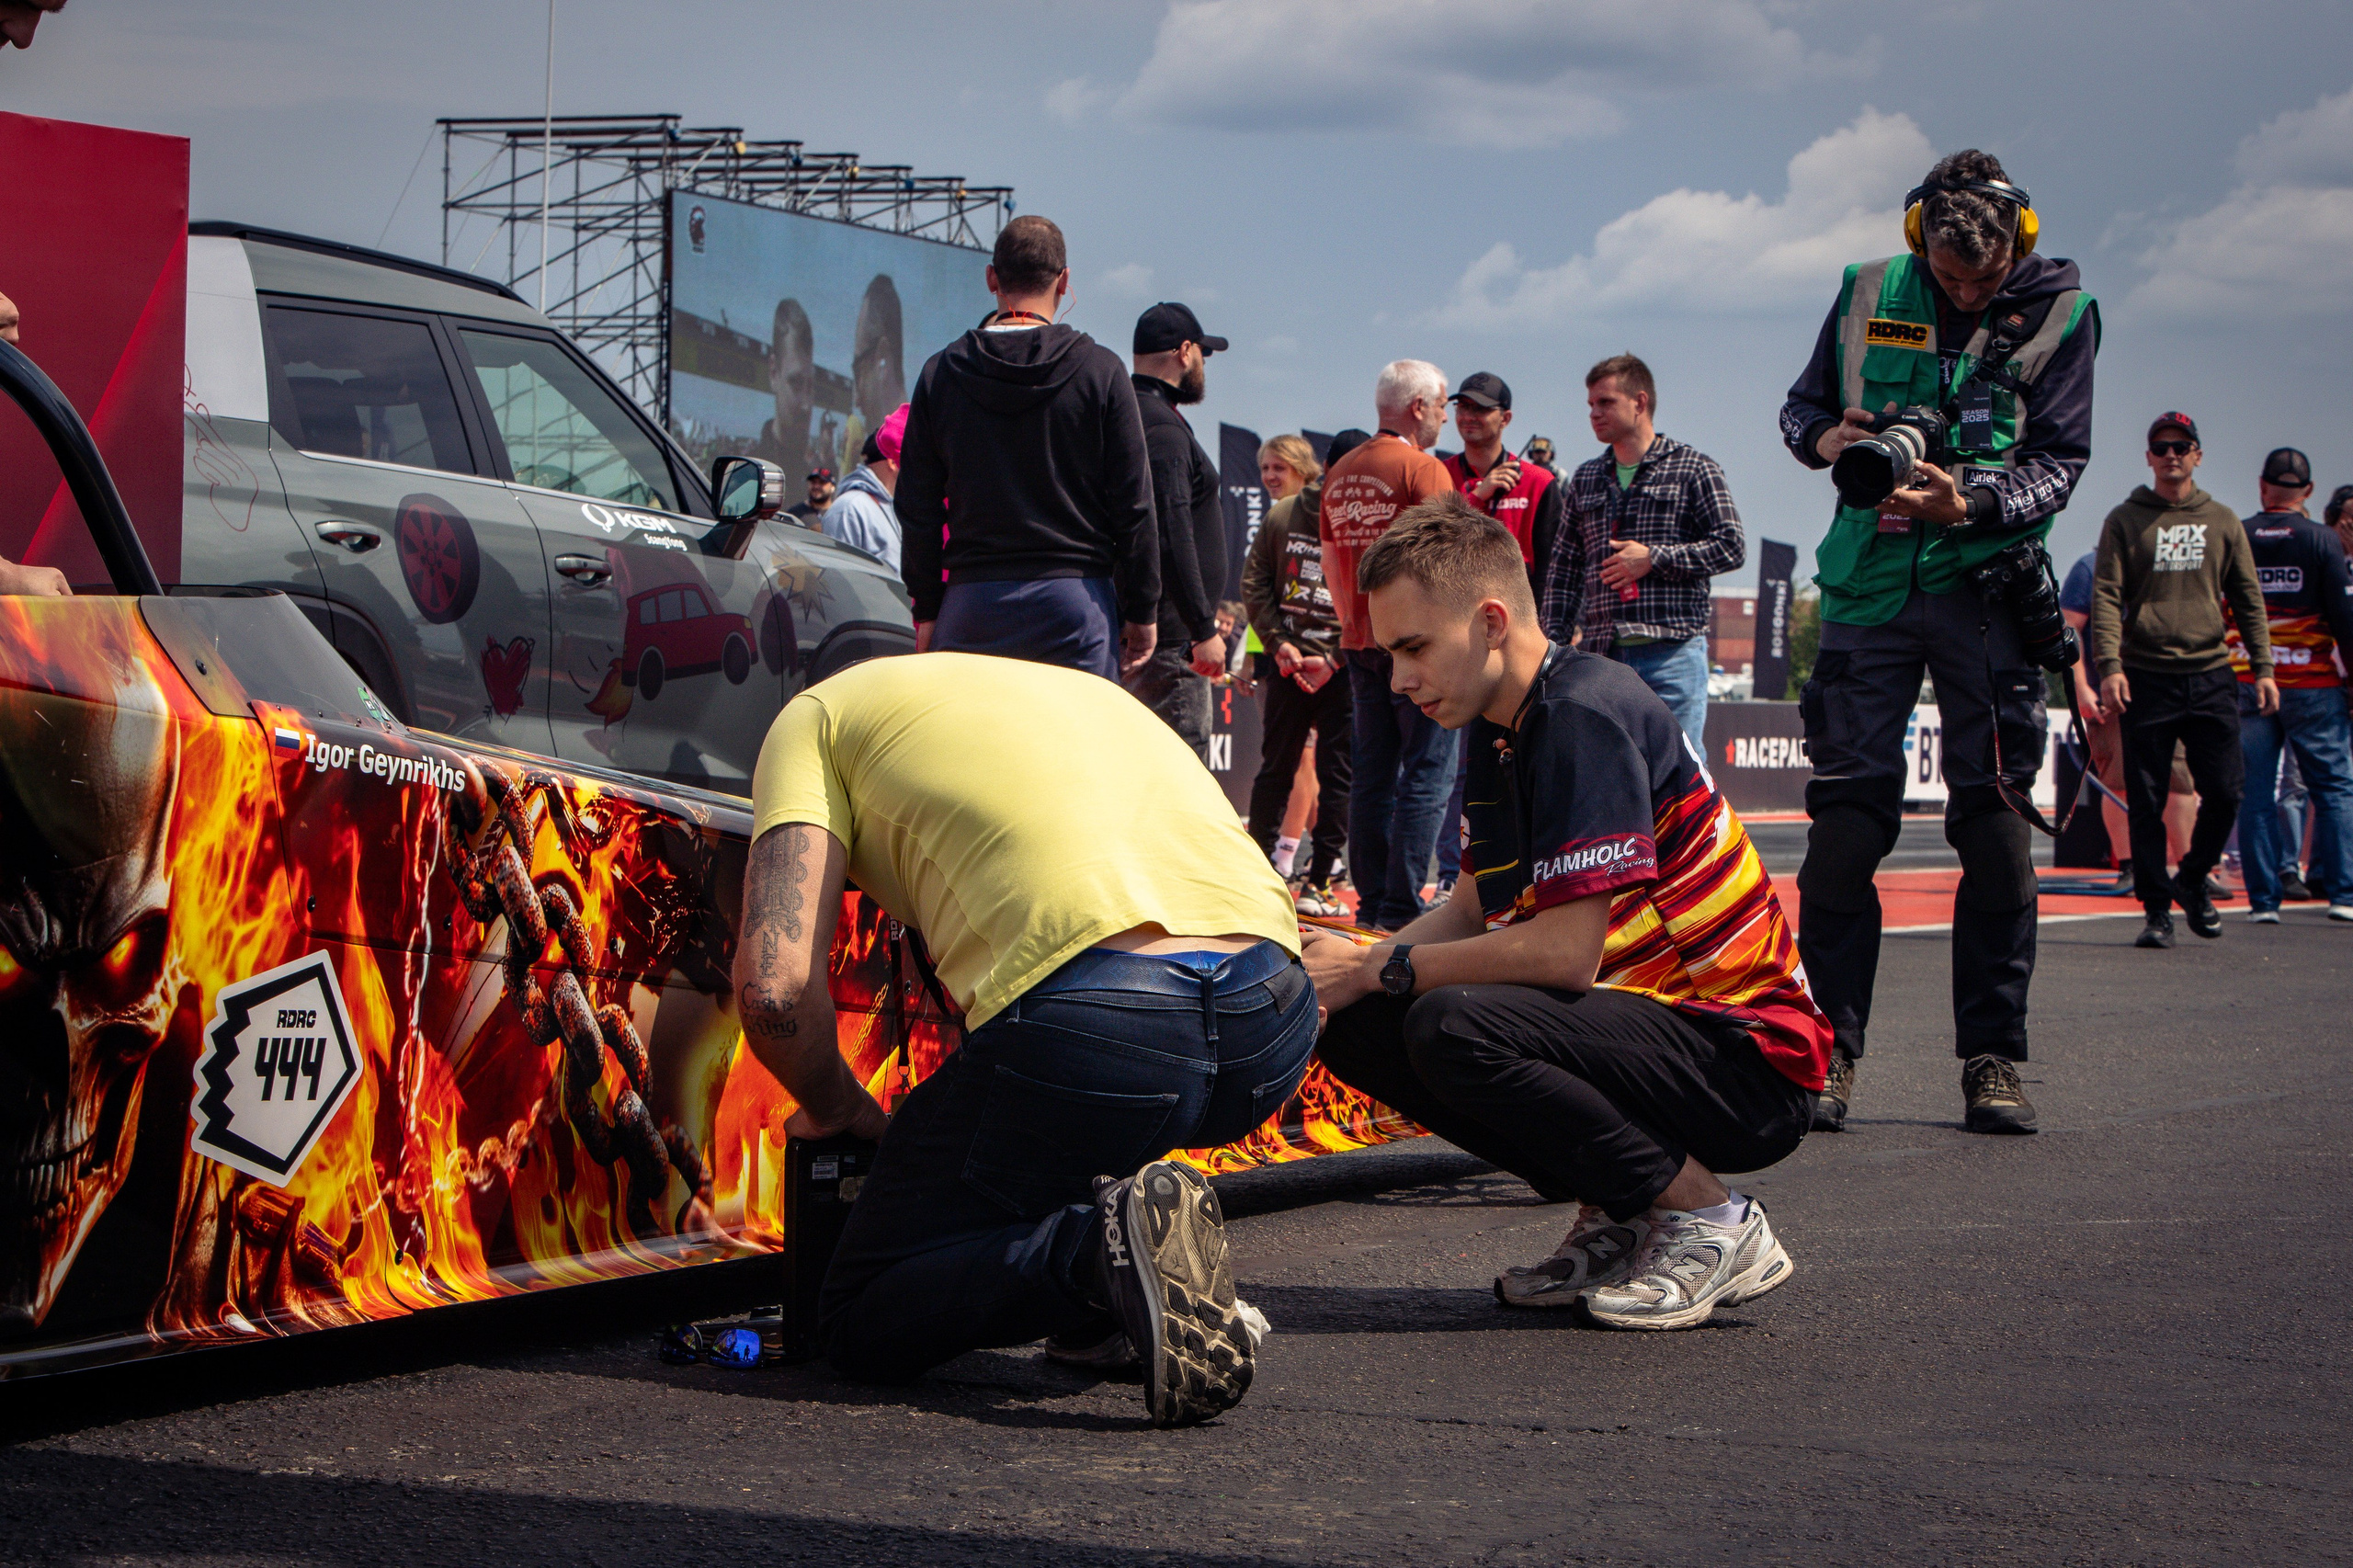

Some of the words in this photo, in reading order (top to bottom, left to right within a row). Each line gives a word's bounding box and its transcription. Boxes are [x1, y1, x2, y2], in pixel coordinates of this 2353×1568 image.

[1867, 322, 1927, 342] RDRC
[1961, 415, 1990, 423] 2025
[613, 511, 677, 534] KGM
[1244, 487, 1263, 558] ONKI
[1347, 500, 1398, 526] Racing
[2156, 524, 2208, 544] MAX
[2153, 560, 2204, 572] MOTORSPORT
[2257, 568, 2301, 584] DRC
[305, 733, 355, 772] Igor
[358, 744, 466, 792] Geynrikhs
[1533, 835, 1637, 883] FLAMHOLC
[1604, 857, 1654, 876] Racing
[277, 1009, 317, 1028] RDRC
[254, 1037, 327, 1101] 444
[1105, 1186, 1130, 1267] HOKA
[1585, 1233, 1622, 1260] N
[1669, 1254, 1711, 1283] N
